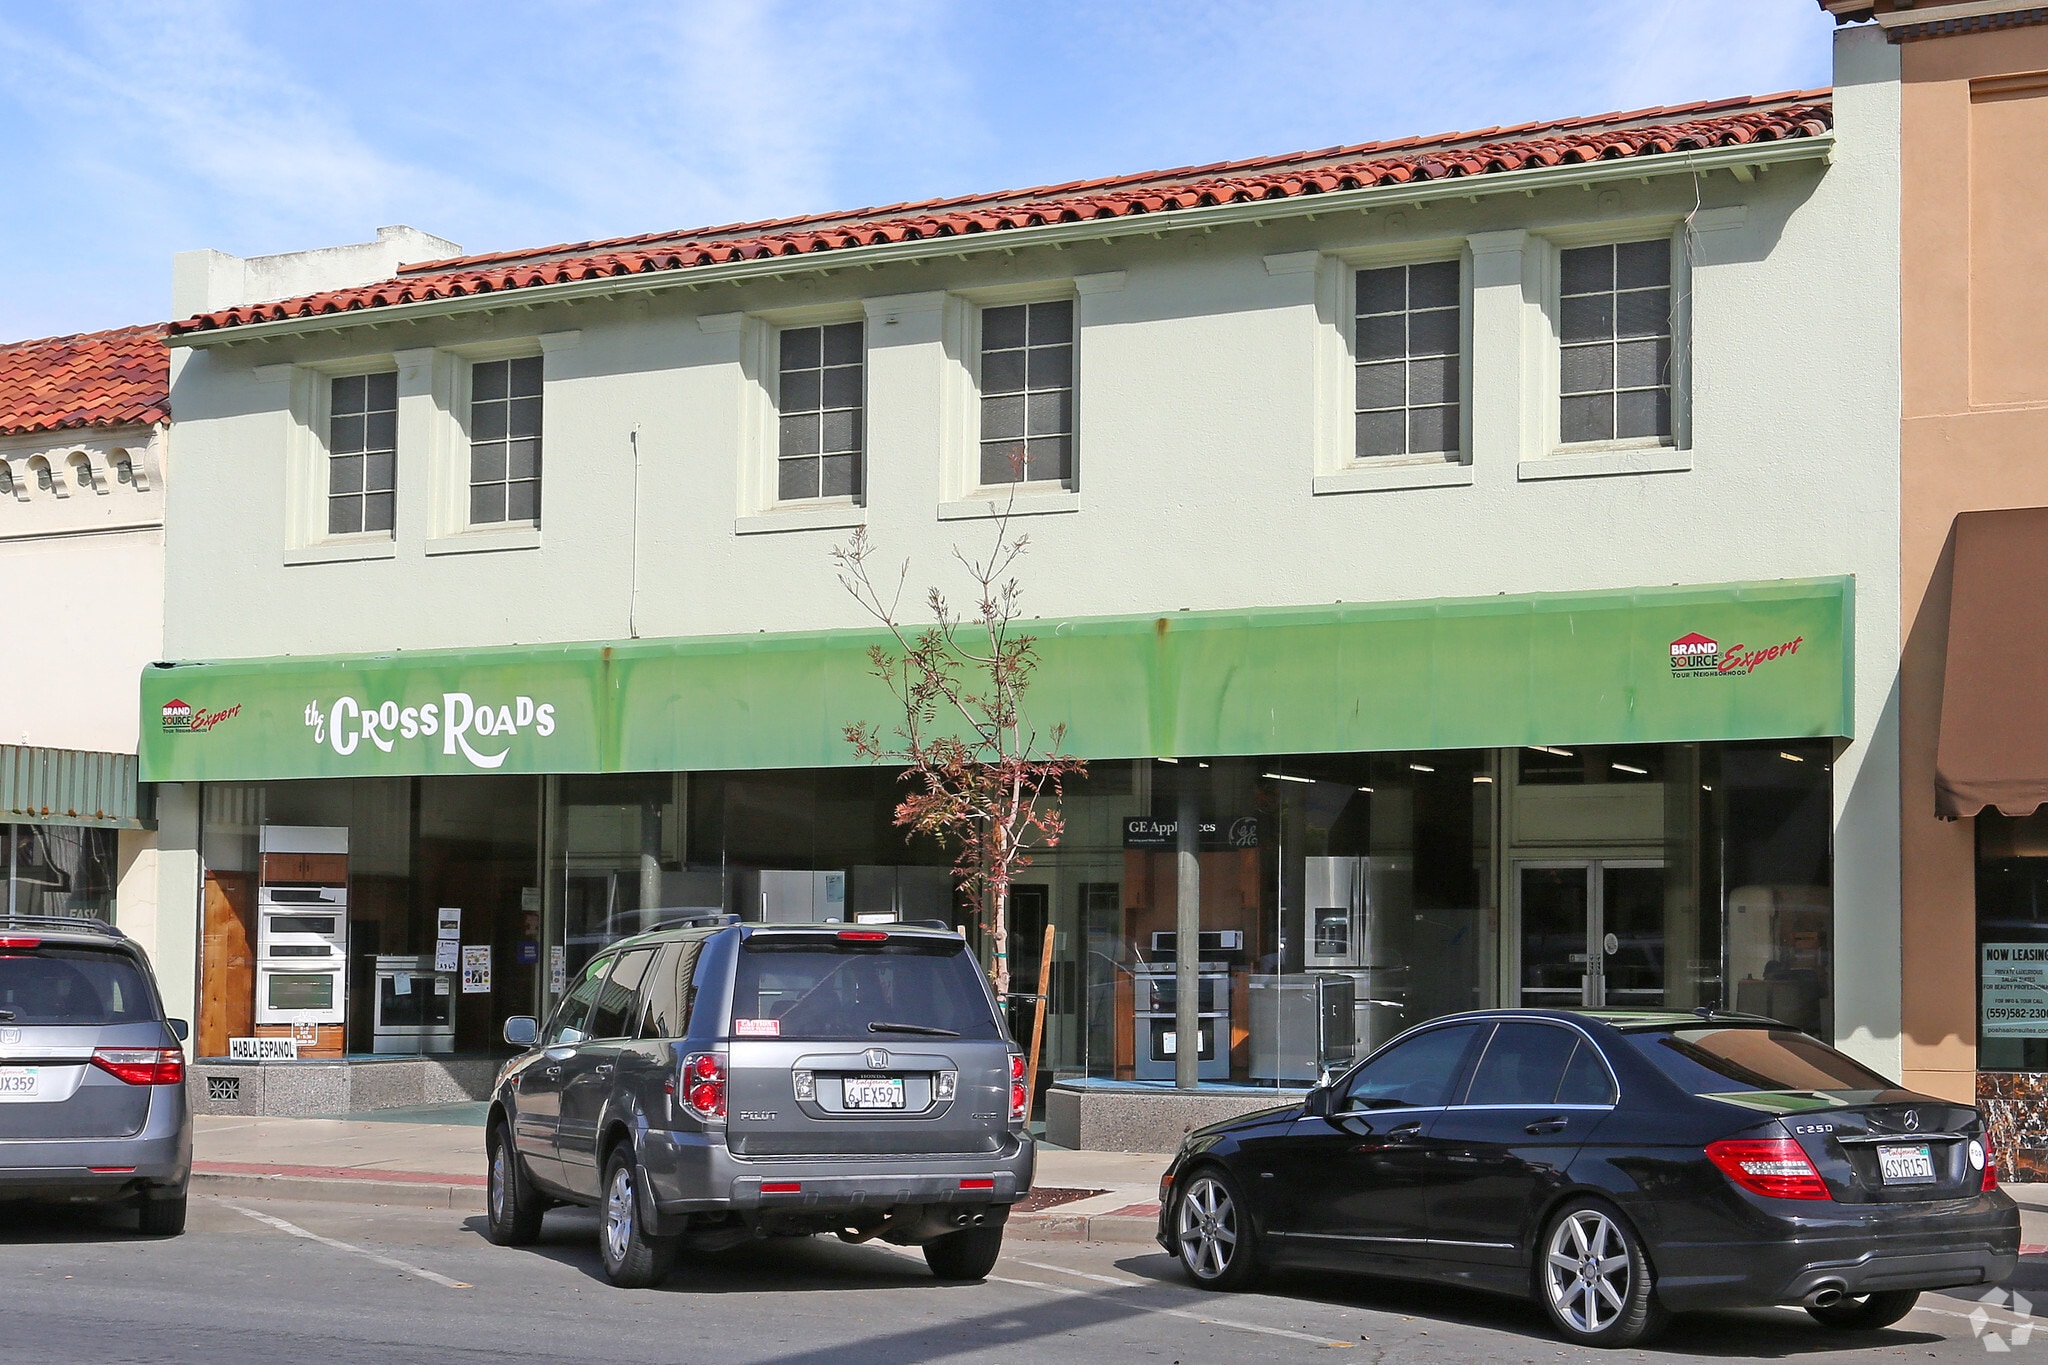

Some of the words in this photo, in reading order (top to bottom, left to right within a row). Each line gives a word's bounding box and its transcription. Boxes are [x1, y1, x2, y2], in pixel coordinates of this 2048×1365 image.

[1671, 642, 1717, 655] BRAND
[1717, 636, 1803, 674] Expert
[1670, 654, 1718, 668] SOURCE
[162, 707, 190, 716] BRAND
[190, 703, 242, 731] Expert
[162, 716, 191, 725] SOURCE
[304, 699, 325, 744] the
[330, 696, 439, 756] CROSS
[443, 692, 556, 769] ROADS
[1128, 821, 1148, 833] GE
[1150, 821, 1216, 836] Applces
[1986, 948, 2009, 961] NOW
[1986, 1007, 2048, 1020] (559)582-230
[232, 1040, 258, 1058] HABLA
[260, 1040, 294, 1058] ESPANOL
[848, 1087, 901, 1103] 6JEX597
[1795, 1126, 1805, 1134] C
[1806, 1124, 1833, 1134] 250
[1885, 1158, 1930, 1178] 6SYR157
